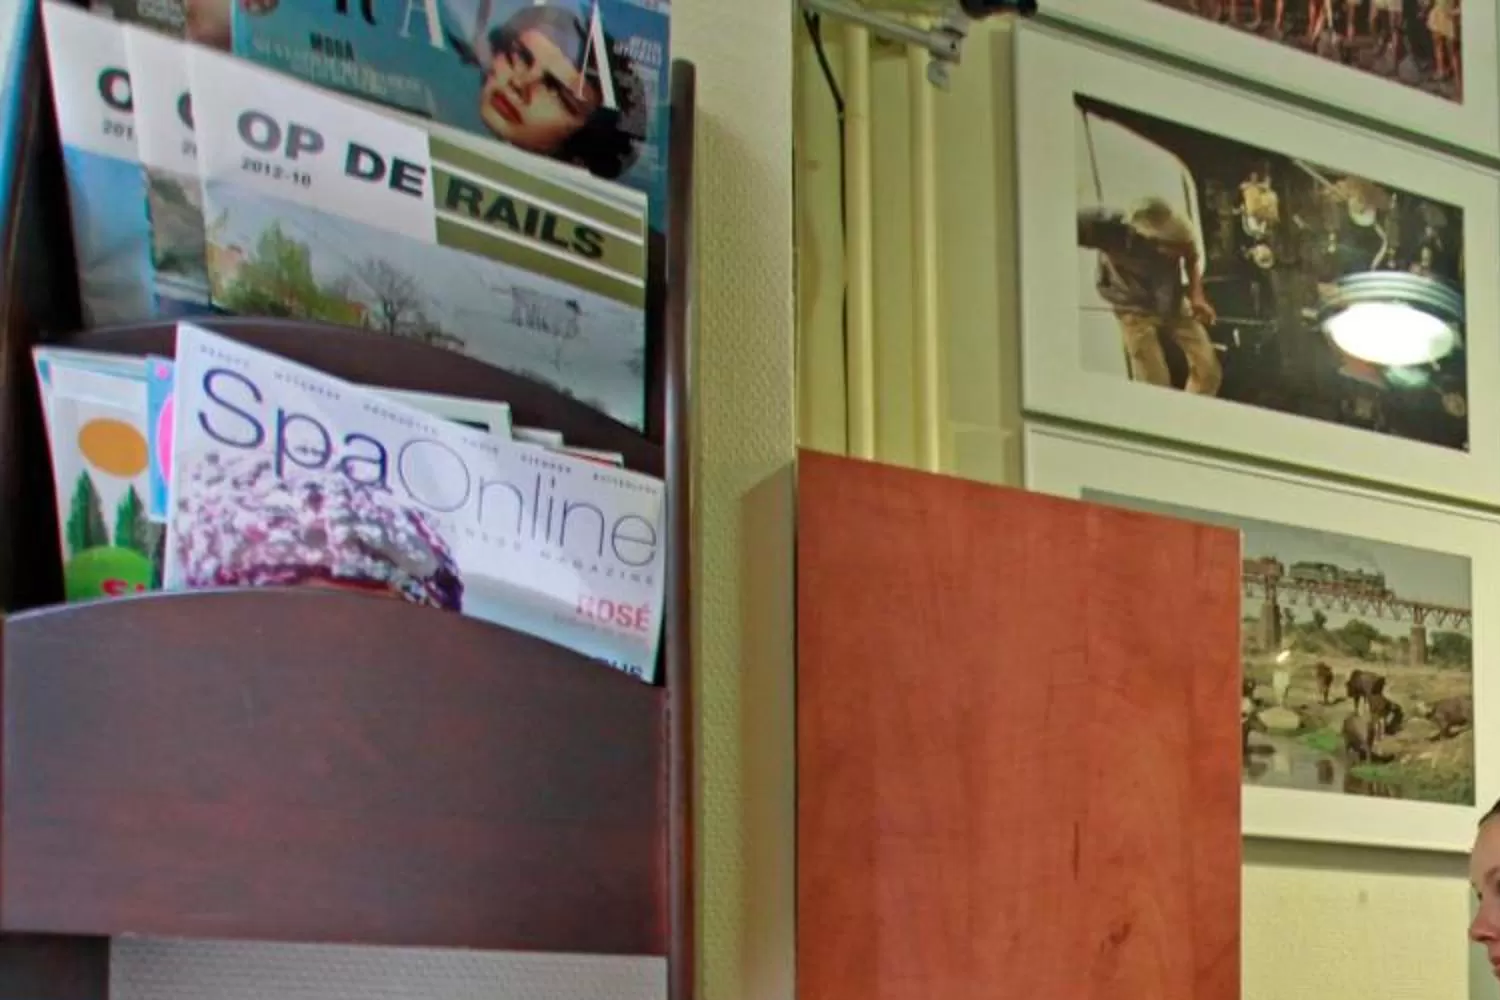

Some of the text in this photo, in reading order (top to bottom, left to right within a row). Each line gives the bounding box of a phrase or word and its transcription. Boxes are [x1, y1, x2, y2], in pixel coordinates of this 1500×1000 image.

[236, 109, 325, 161] OP
[343, 140, 427, 198] DE
[445, 175, 606, 260] RAILS
[240, 155, 313, 188] 2012-10
[197, 366, 657, 567] SpaOnline
